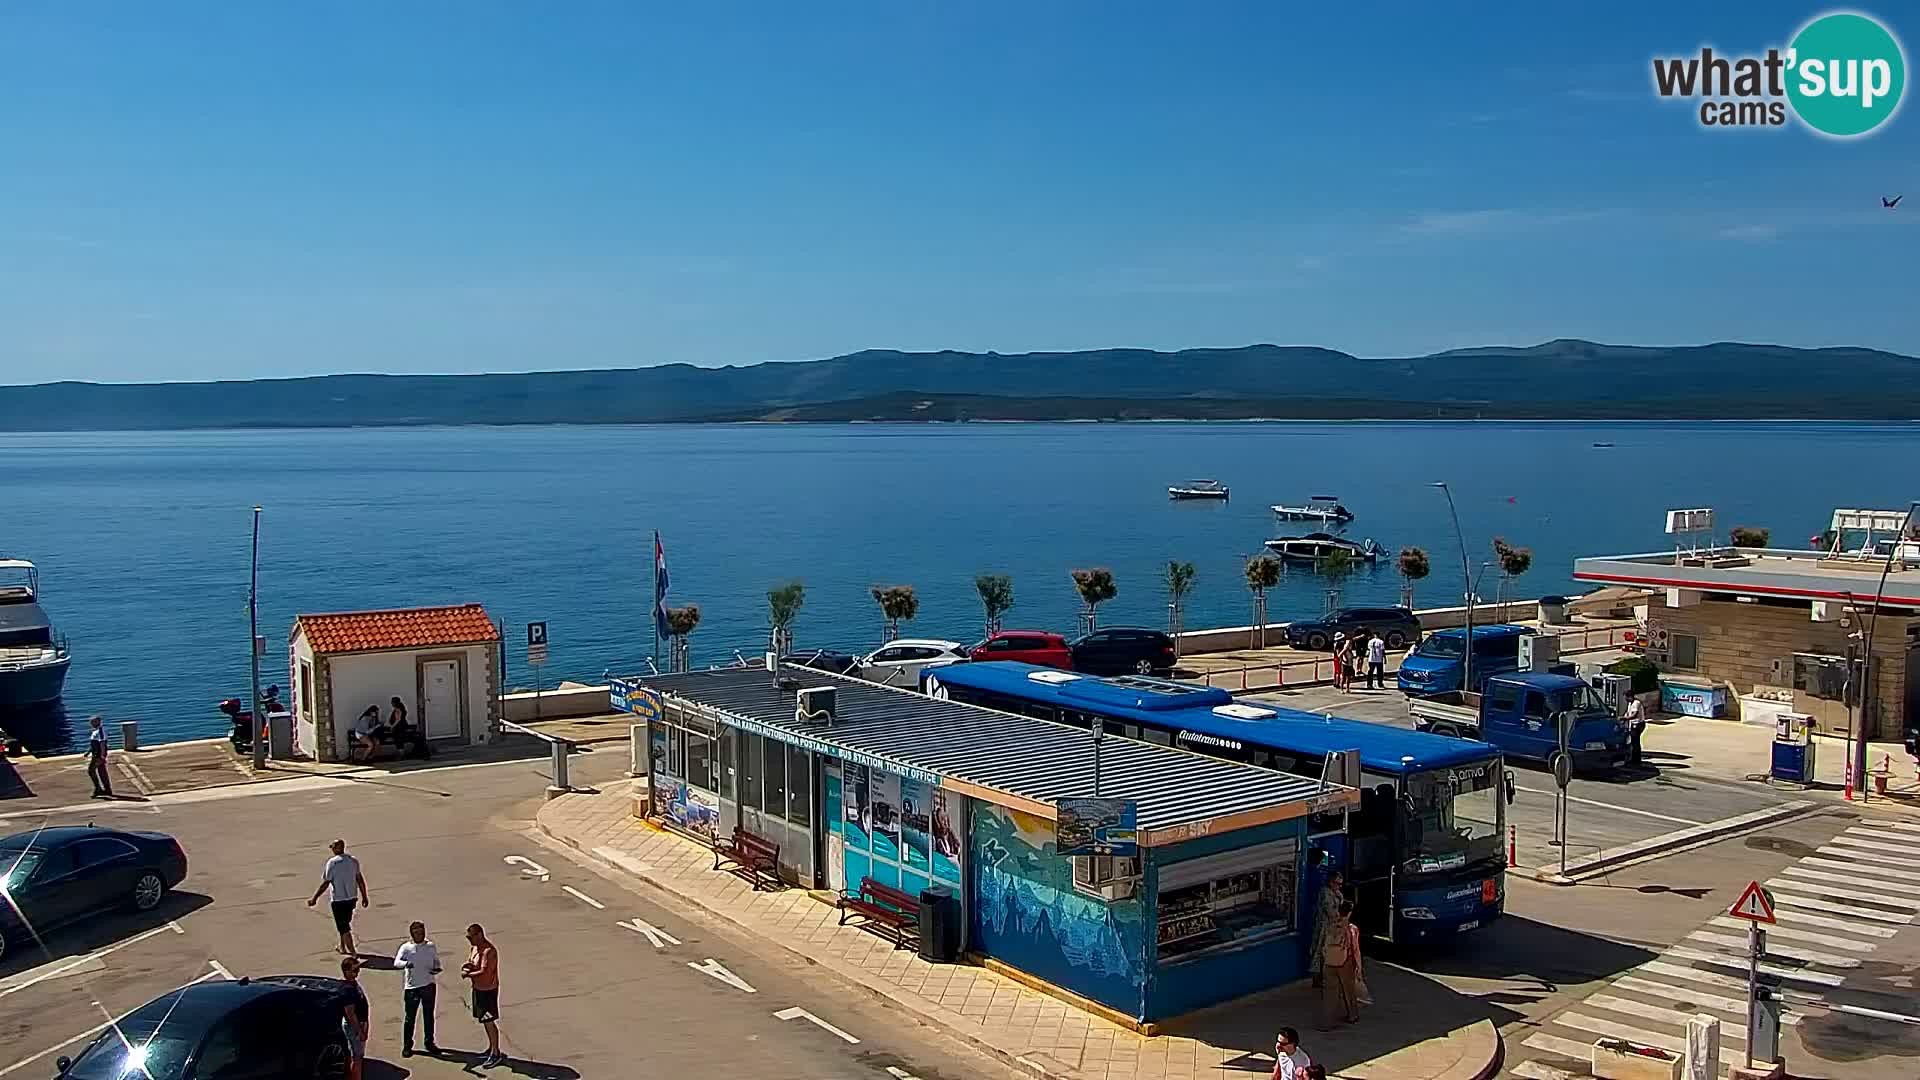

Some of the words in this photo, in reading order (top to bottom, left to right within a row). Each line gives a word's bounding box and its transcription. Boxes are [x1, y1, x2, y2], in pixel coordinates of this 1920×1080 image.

[531, 625, 543, 642] P
[762, 728, 799, 745] AUTOBUSNA
[800, 738, 829, 753] POSTAJA
[838, 748, 853, 760] BUS
[852, 750, 883, 769] STATION
[885, 761, 911, 777] TICKET
[910, 769, 937, 784] OFFICE
